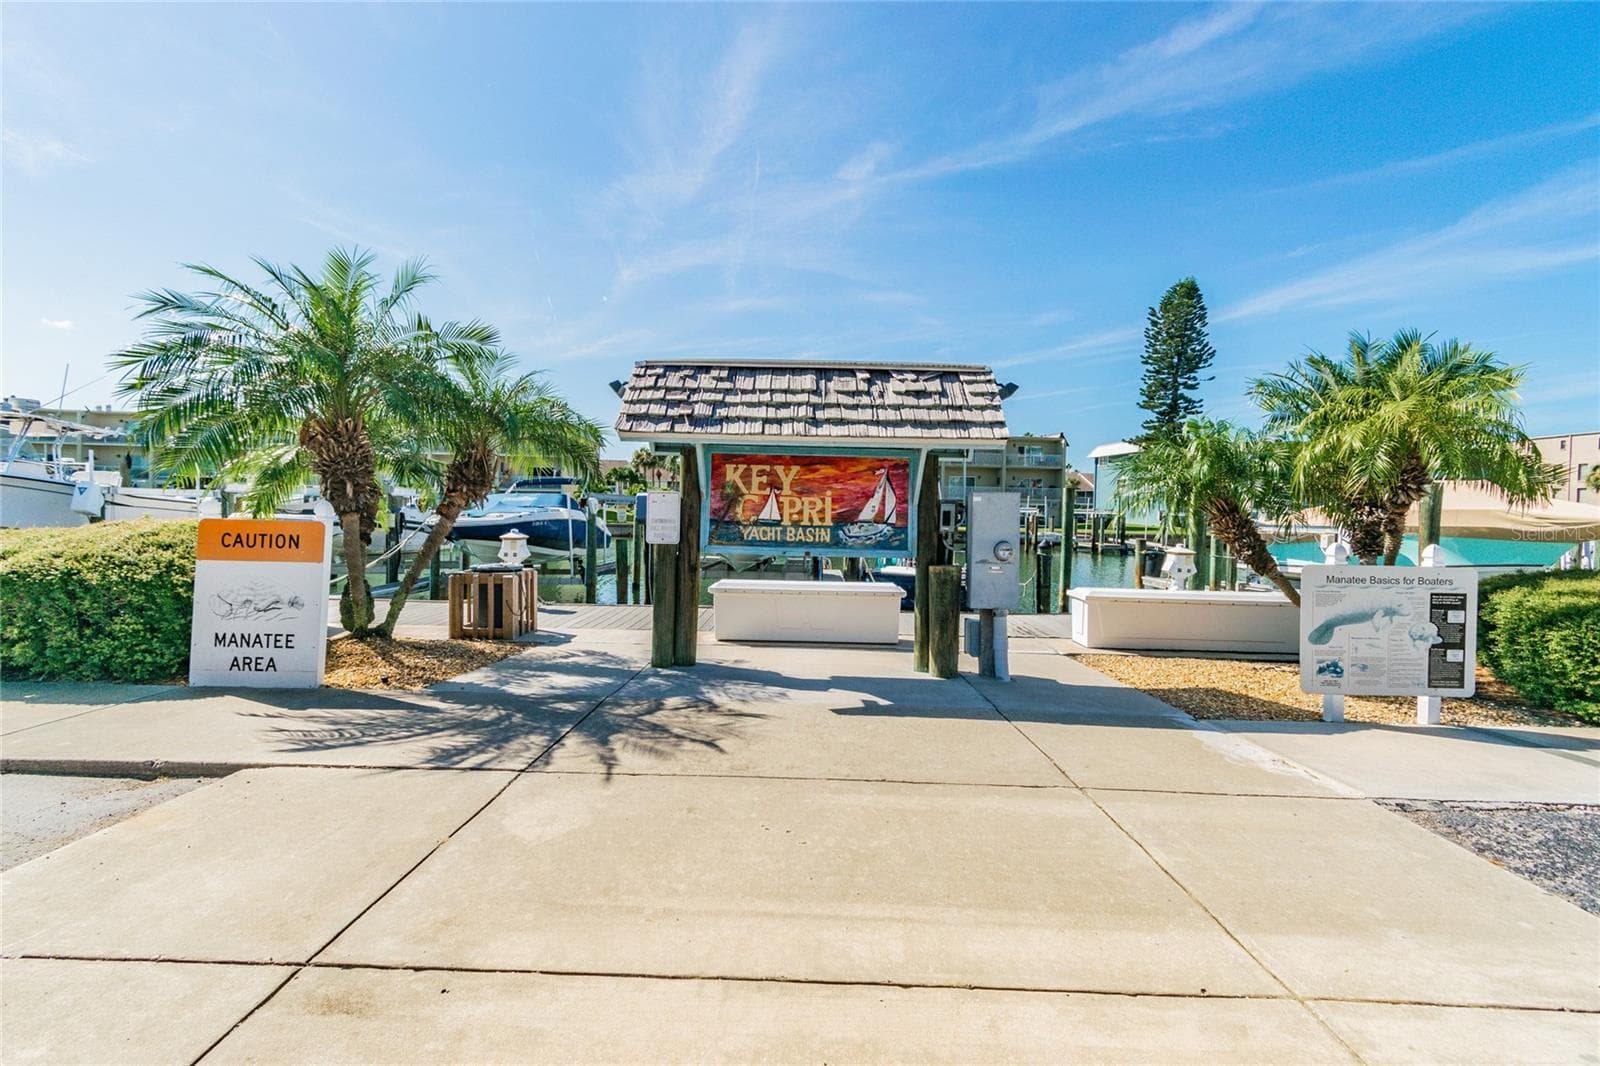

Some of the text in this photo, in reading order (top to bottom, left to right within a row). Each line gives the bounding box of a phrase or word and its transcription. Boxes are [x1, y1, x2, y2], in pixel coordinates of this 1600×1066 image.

[725, 464, 800, 496] KEY
[221, 532, 300, 549] CAUTION
[741, 525, 782, 542] YACHT
[786, 528, 831, 543] BASIN
[1326, 575, 1454, 586] Manatee Basics for Boaters
[214, 632, 295, 649] MANATEE
[229, 656, 277, 672] AREA
